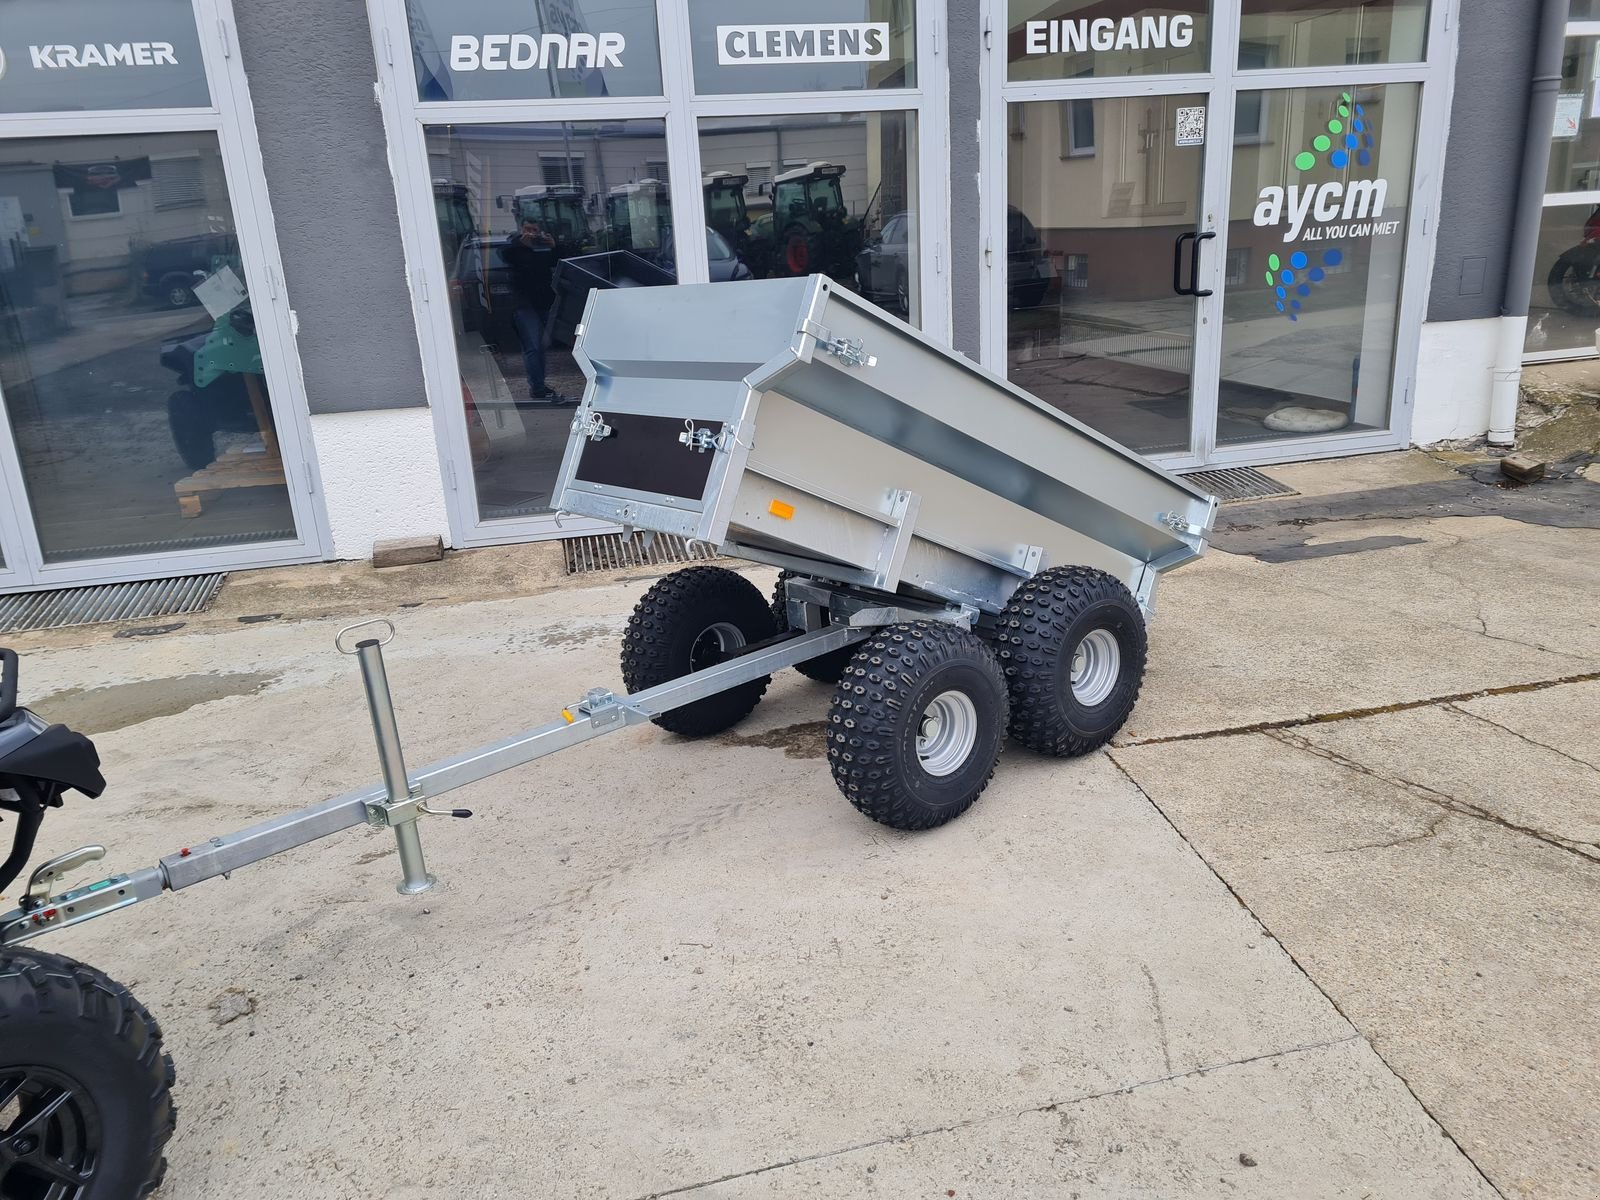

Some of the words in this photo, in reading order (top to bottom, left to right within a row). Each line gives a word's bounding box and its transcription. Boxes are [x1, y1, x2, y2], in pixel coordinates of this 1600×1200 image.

[724, 28, 884, 58] CLEMENS
[1026, 14, 1194, 54] EINGANG
[29, 42, 179, 69] KRAMER
[449, 32, 626, 72] BEDNAR
[1253, 178, 1388, 243] aycm
[1302, 227, 1323, 241] ALL
[1325, 225, 1348, 240] YOU
[1349, 223, 1371, 238] CAN
[1372, 221, 1400, 235] MIET
